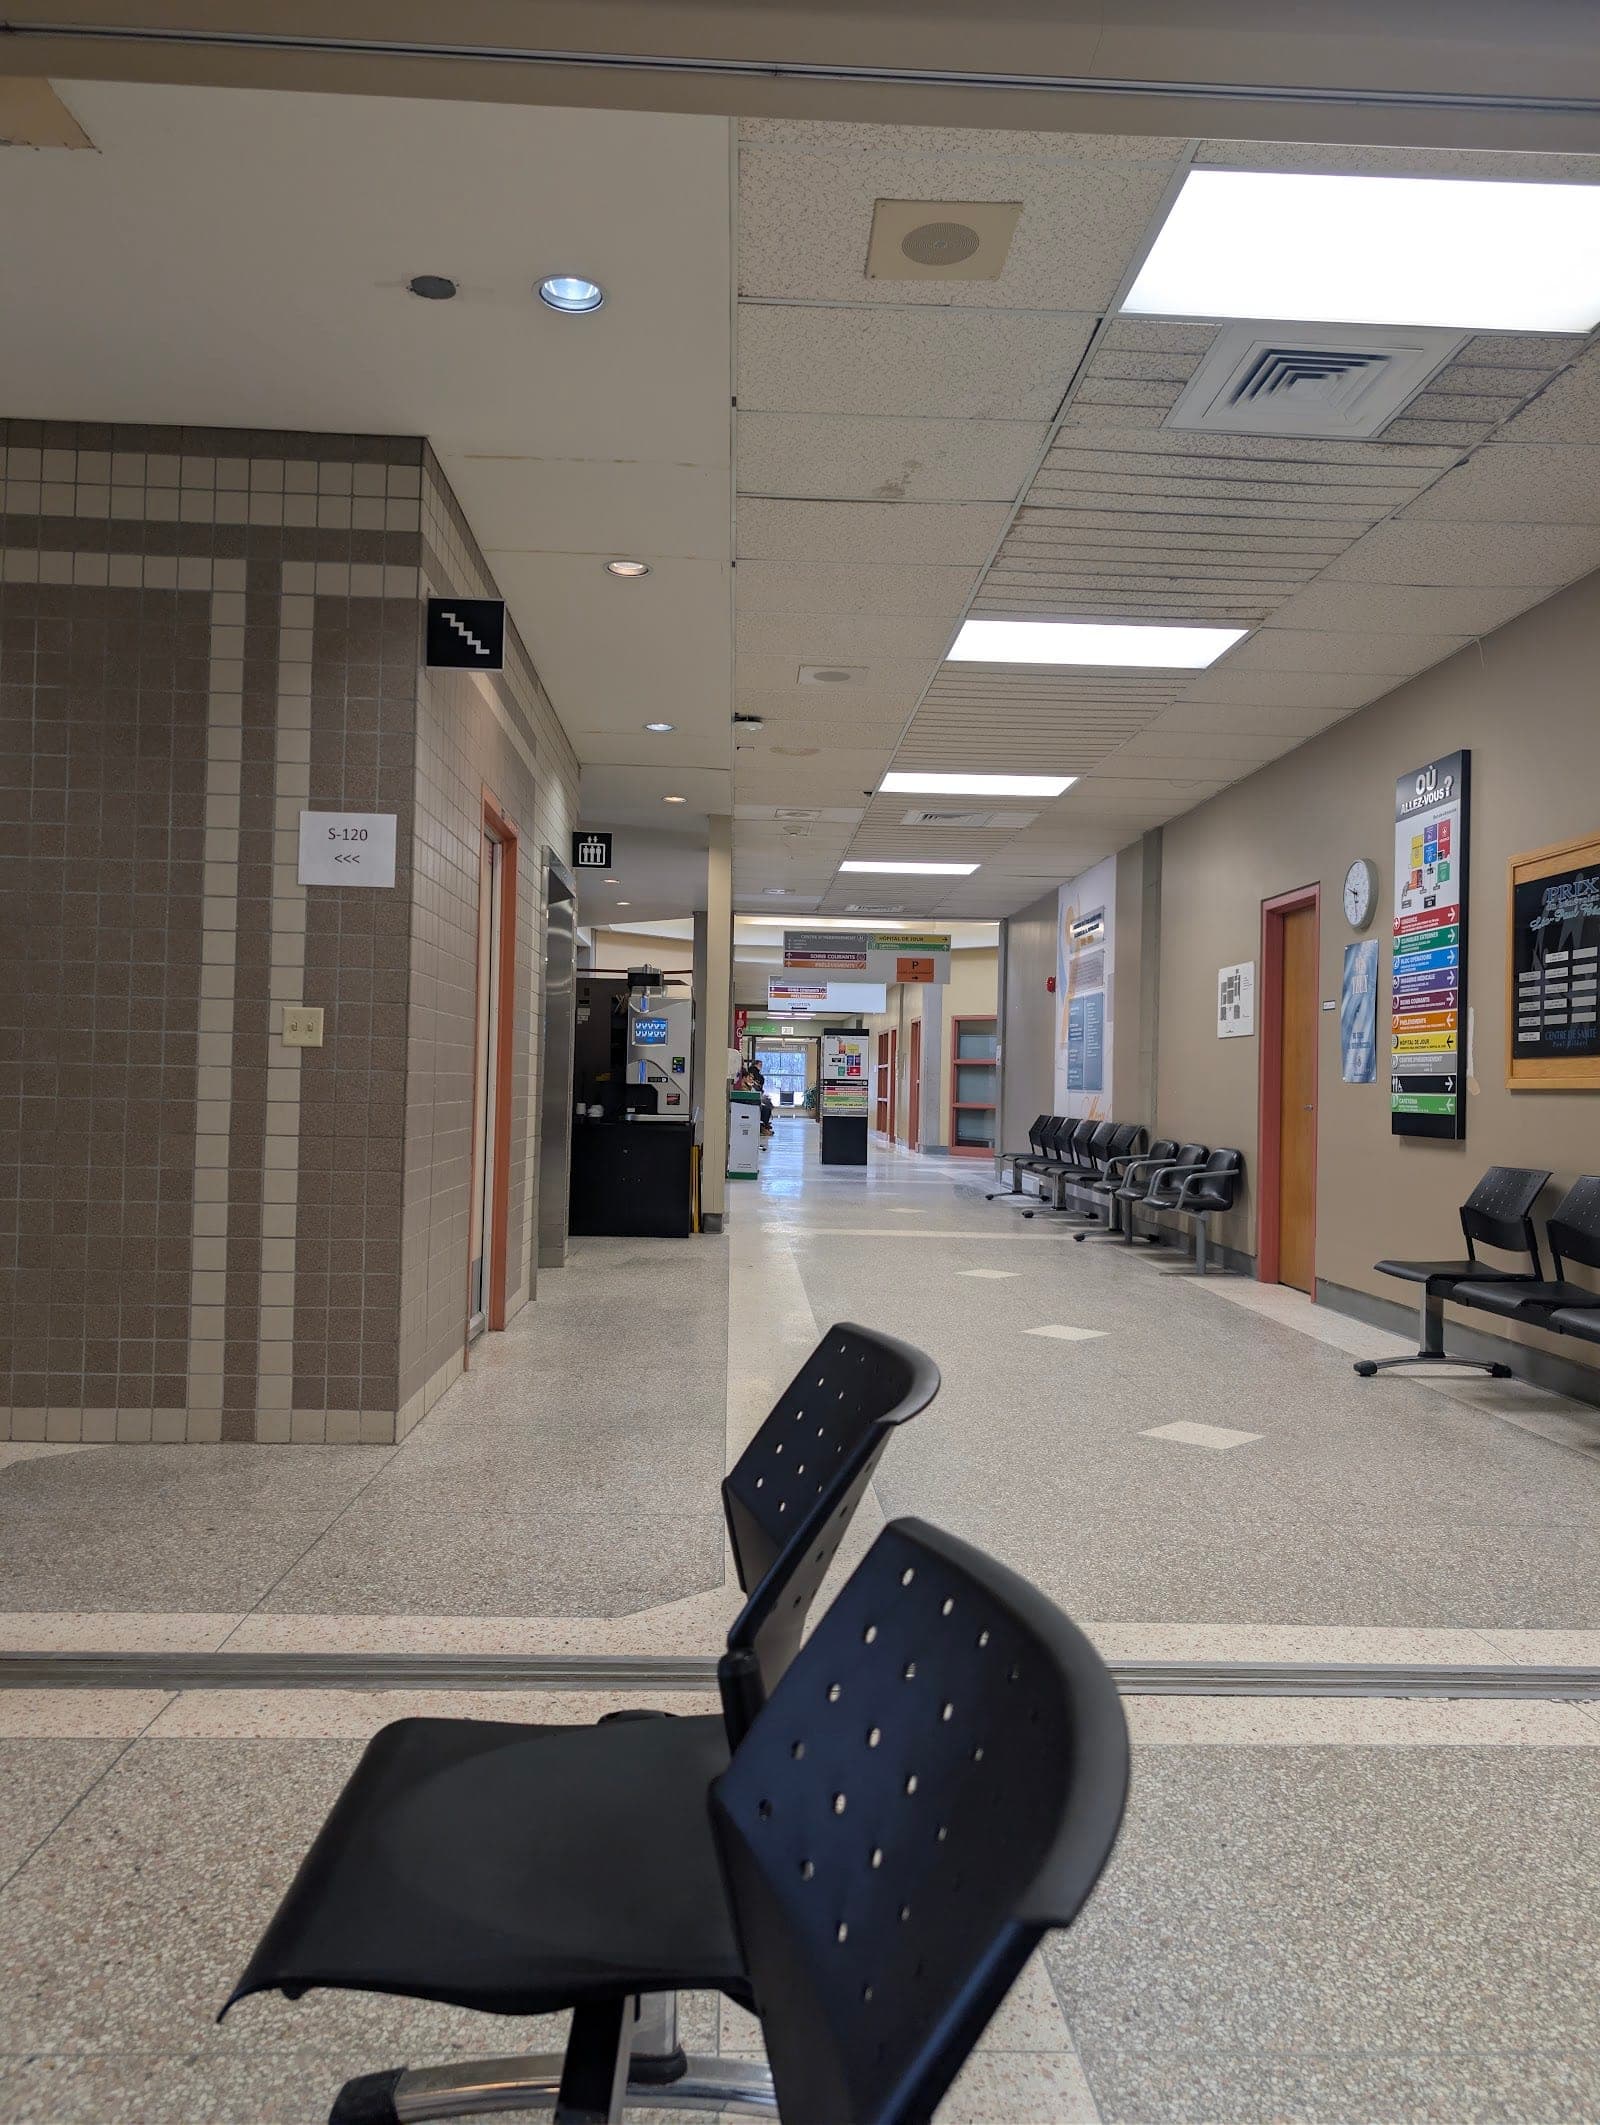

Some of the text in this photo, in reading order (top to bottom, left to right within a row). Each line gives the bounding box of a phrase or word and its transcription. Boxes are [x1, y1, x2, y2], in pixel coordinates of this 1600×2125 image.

[1416, 765, 1437, 795] OÙ
[328, 827, 368, 841] S-120
[1546, 877, 1599, 904] PRIX
[912, 961, 919, 969] P
